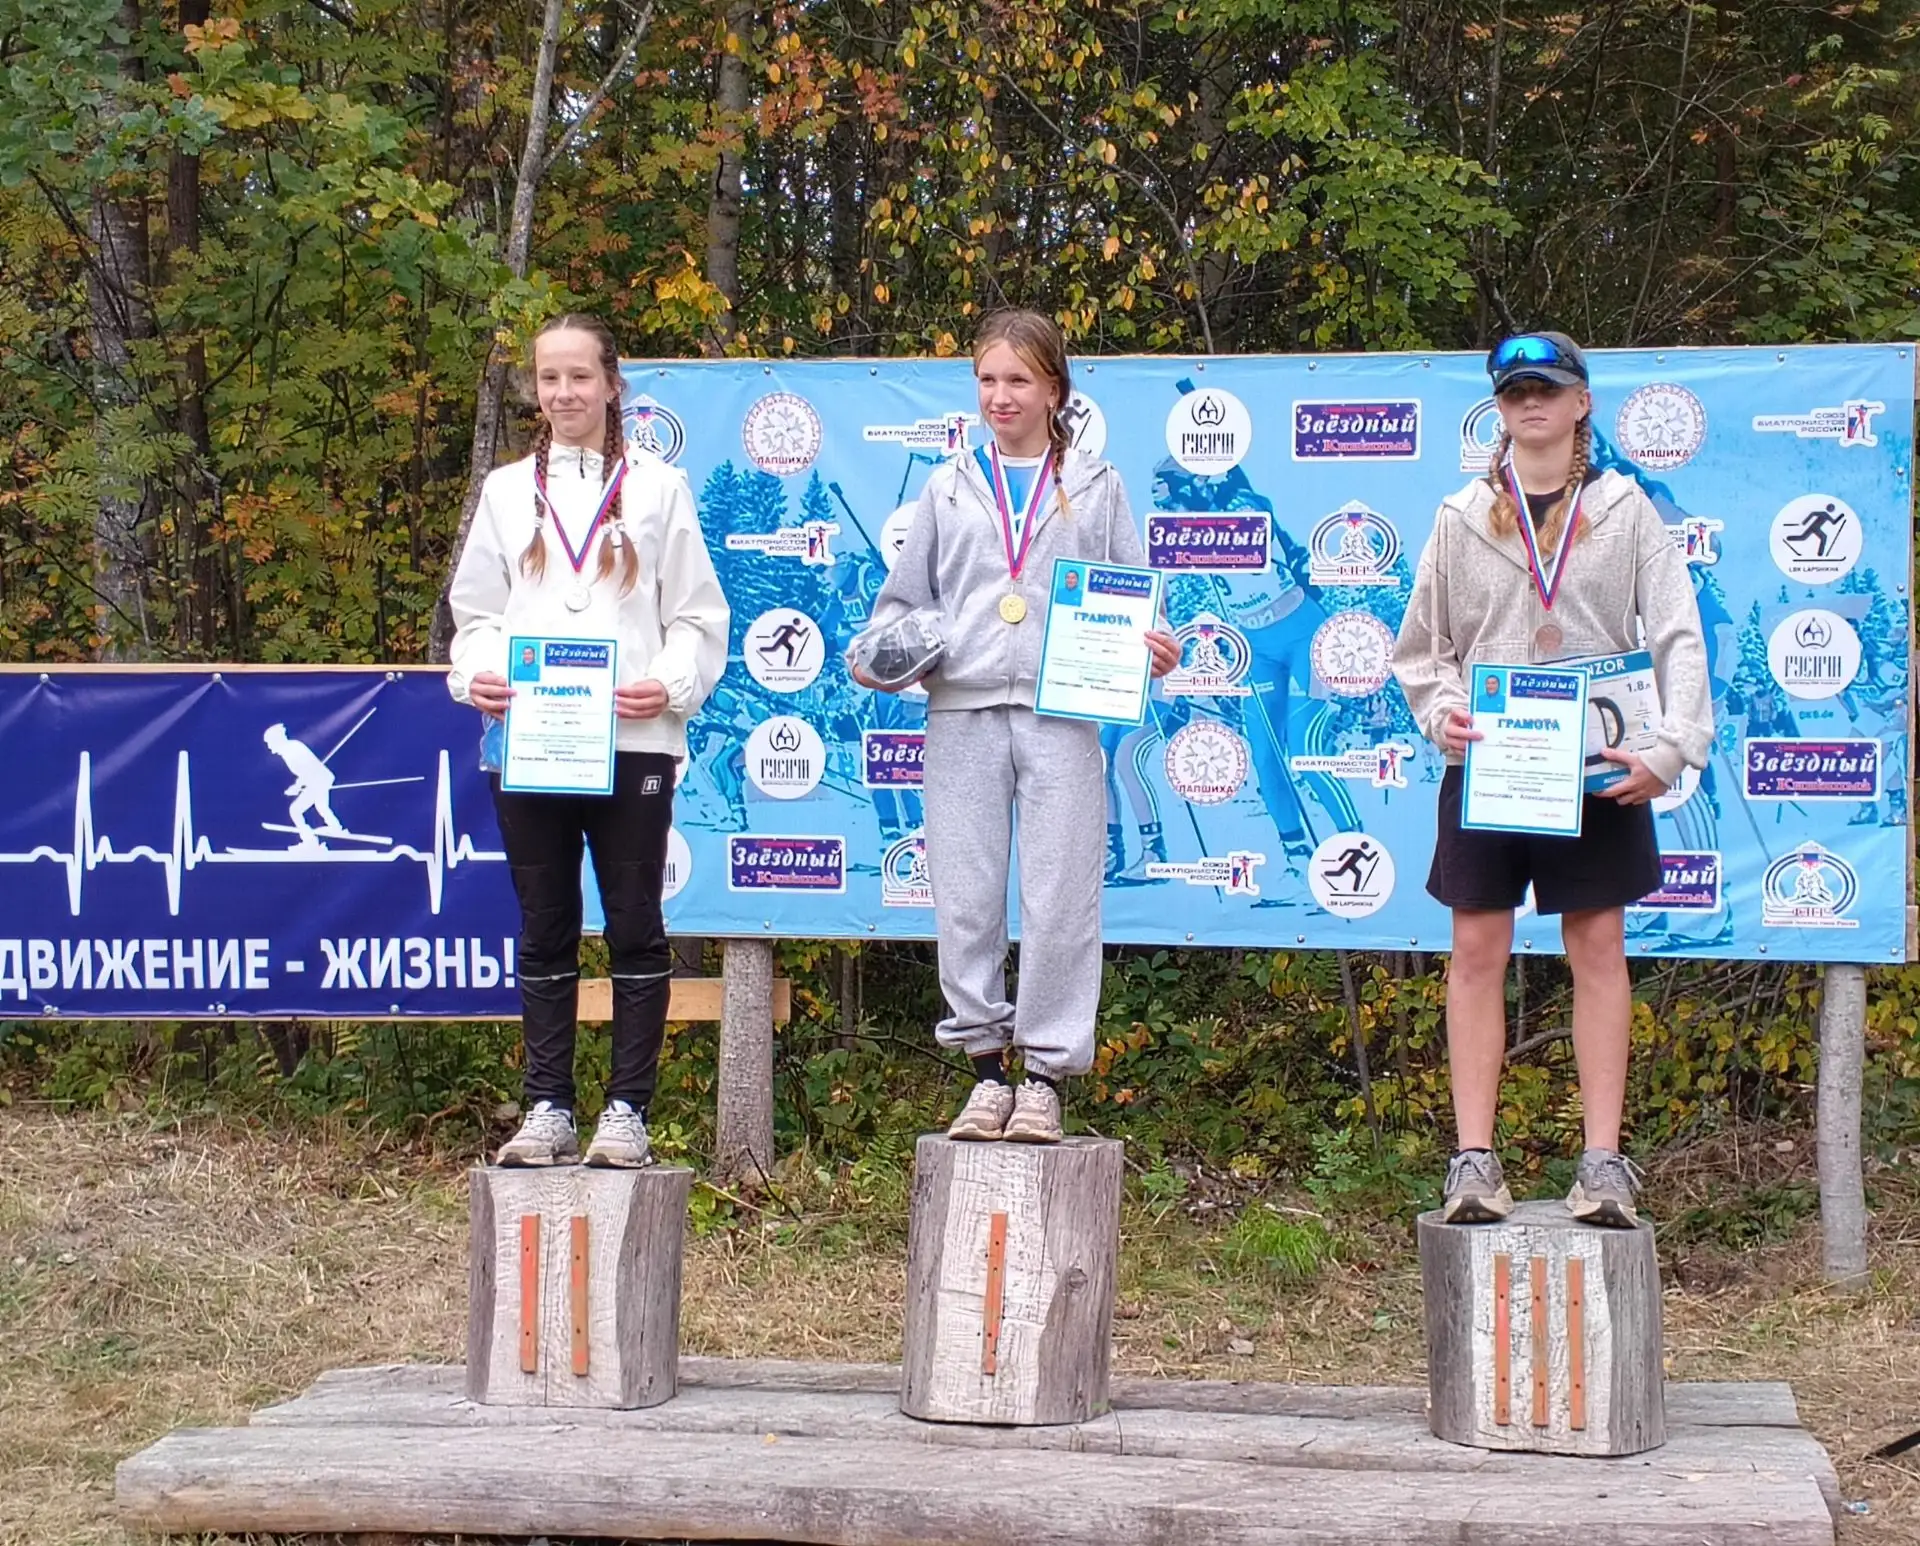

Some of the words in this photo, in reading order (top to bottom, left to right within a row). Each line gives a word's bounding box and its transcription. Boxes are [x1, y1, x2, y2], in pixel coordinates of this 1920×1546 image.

[1297, 413, 1415, 434] Звёздный
[757, 456, 809, 465] ЛАПШИХА
[1631, 449, 1690, 458] ЛАПШИХА
[1150, 526, 1265, 546] Звёздный
[1073, 611, 1133, 627] ГРАМОТА
[1325, 676, 1381, 684] ЛАПШИХА
[533, 686, 592, 697] ГРАМОТА
[1497, 718, 1560, 732] ГРАМОТА
[1748, 752, 1875, 773] Звёздный
[1179, 784, 1234, 793] ЛАПШИХА
[732, 846, 840, 868] Звёздный
[0, 937, 270, 1000] ДВИЖЕНИЕ
[320, 937, 515, 989] ЖИЗНЬ!
